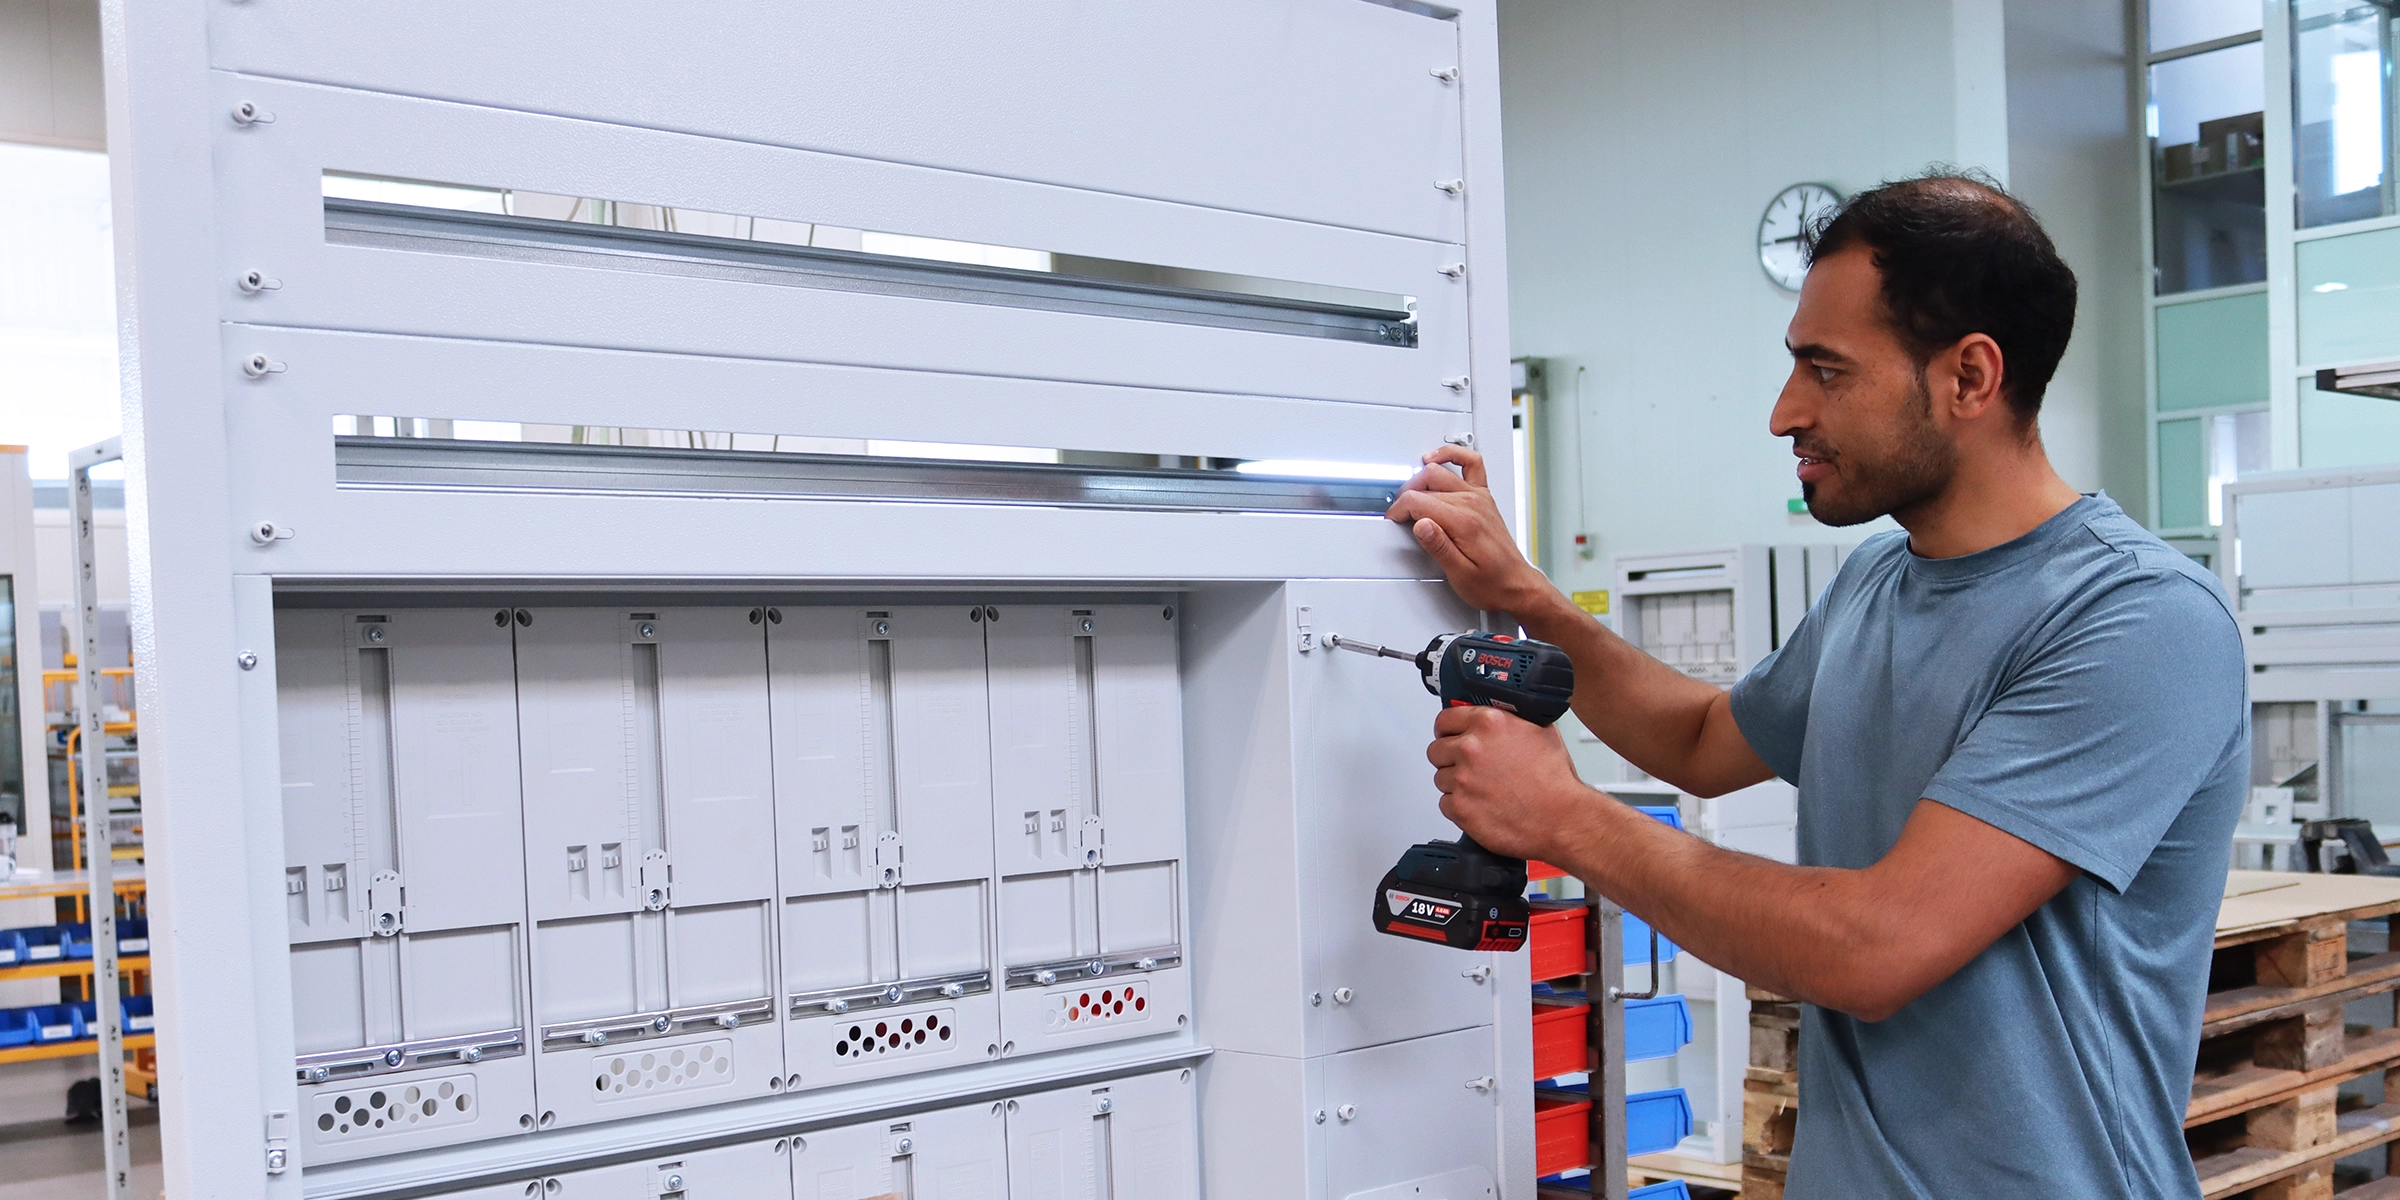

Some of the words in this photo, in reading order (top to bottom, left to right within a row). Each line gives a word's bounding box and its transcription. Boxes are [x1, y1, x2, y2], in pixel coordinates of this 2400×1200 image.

[1478, 653, 1514, 669] BOSCH
[1395, 894, 1411, 902] BOSCH
[1411, 902, 1435, 916] 18V
